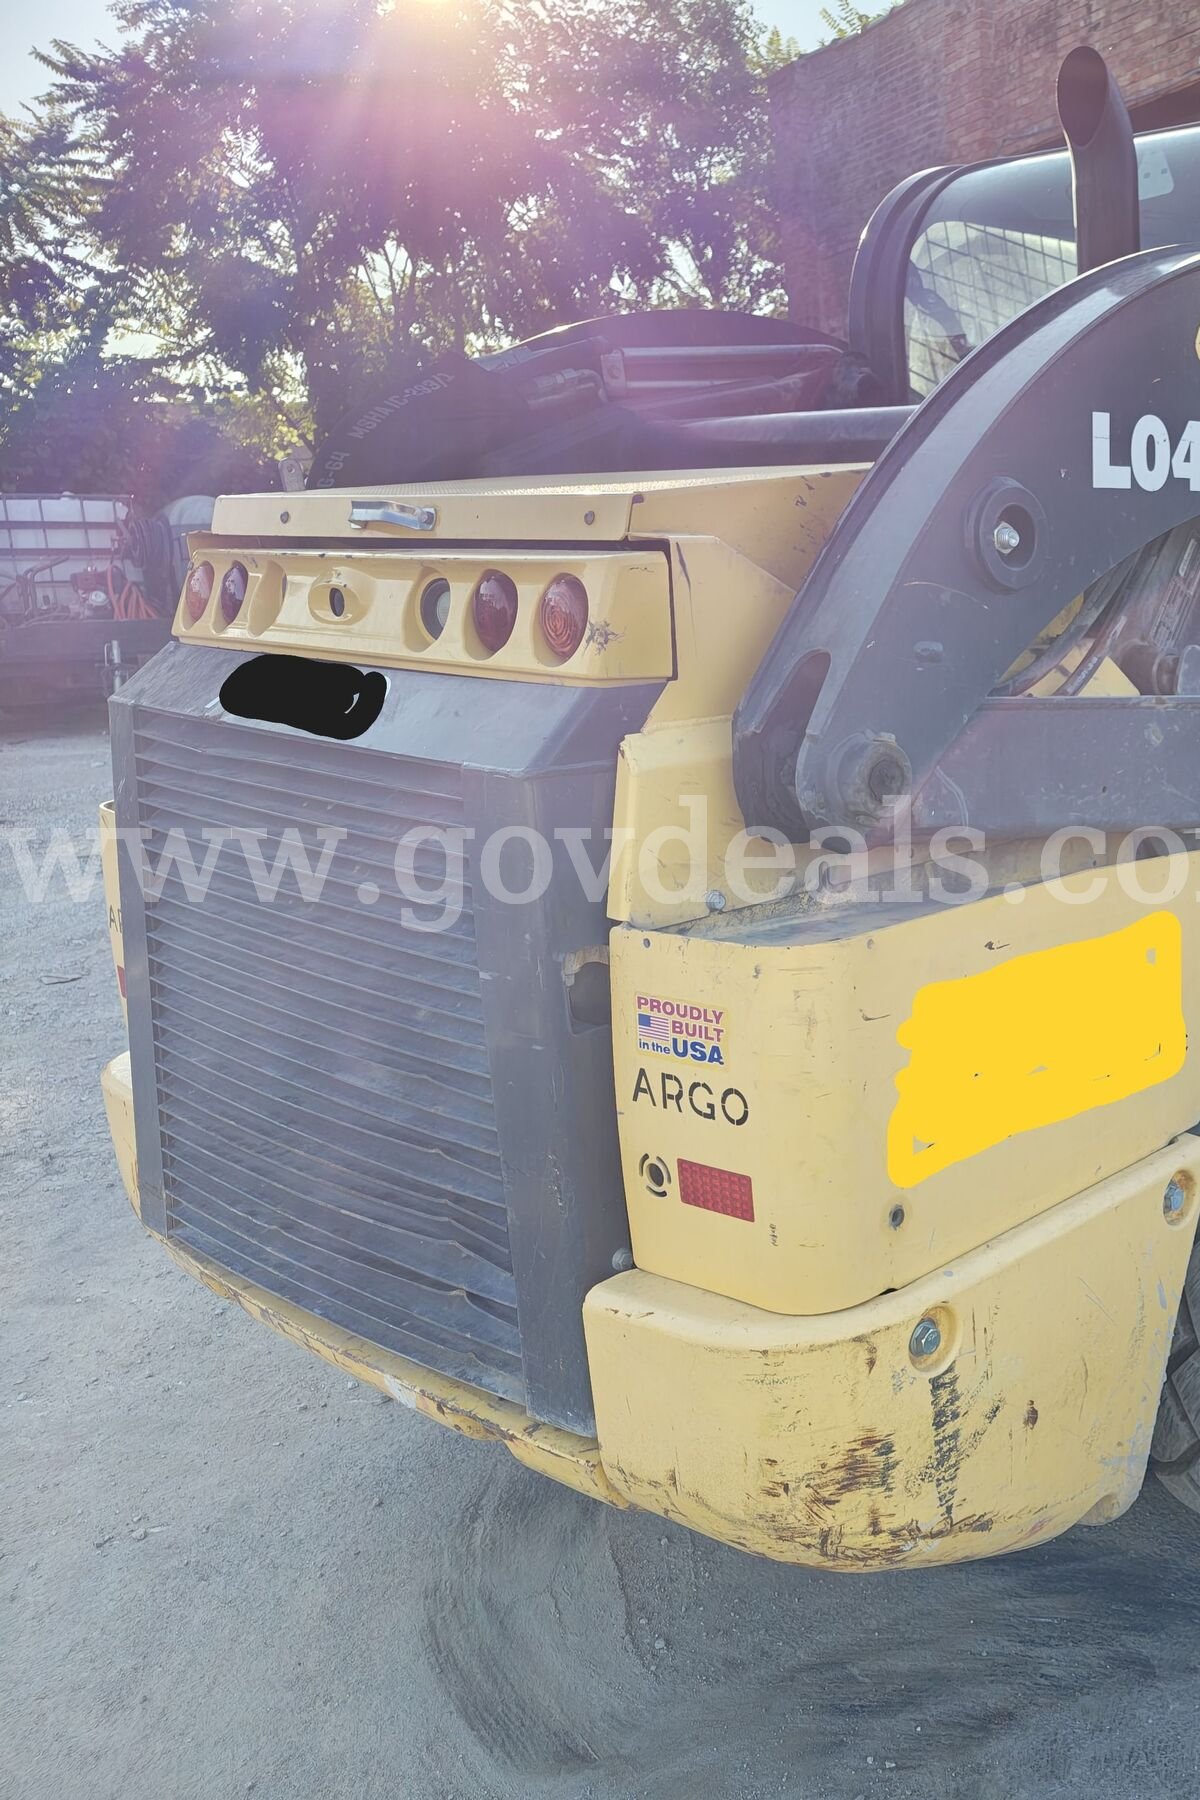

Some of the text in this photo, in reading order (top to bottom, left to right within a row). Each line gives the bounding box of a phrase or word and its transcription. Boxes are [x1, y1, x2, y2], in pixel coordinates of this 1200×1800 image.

[347, 406, 394, 439] MSHA
[636, 996, 723, 1025] PROUDLY
[671, 1020, 724, 1042] BUILT
[639, 1037, 724, 1066] in the USA
[632, 1067, 749, 1126] ARGO
